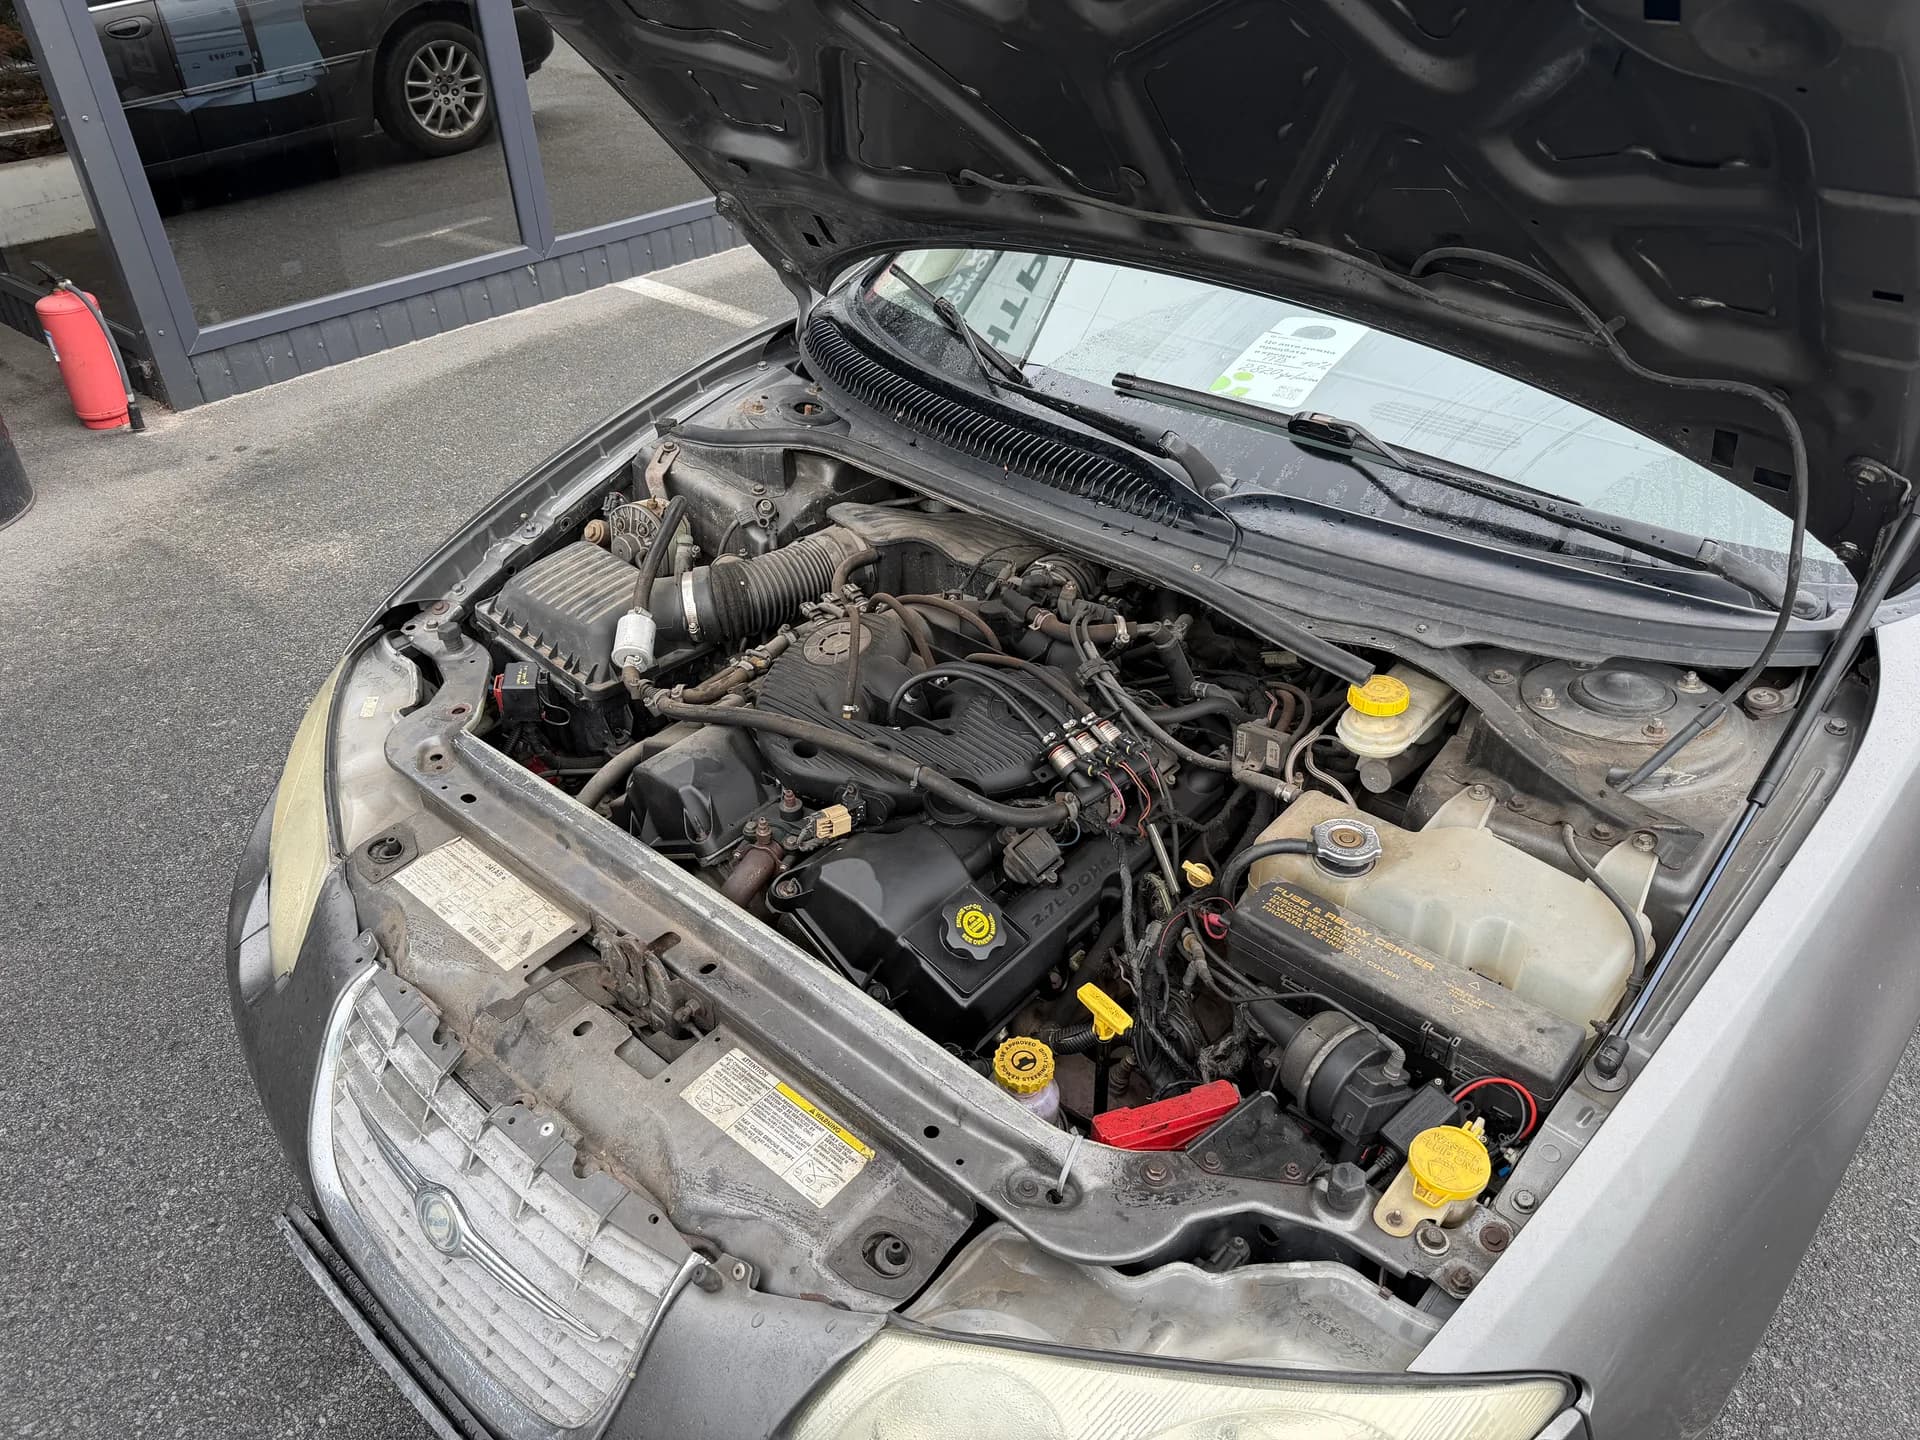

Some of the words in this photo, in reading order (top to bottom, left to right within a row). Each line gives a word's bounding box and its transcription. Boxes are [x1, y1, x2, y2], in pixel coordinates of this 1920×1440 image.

[1265, 902, 1303, 924] ALWAYS
[1273, 886, 1312, 908] FUSE
[1312, 906, 1322, 914] &
[1324, 911, 1372, 938] RELAY
[1374, 937, 1436, 971] CENTER
[1262, 905, 1309, 931] PROPERLY
[1367, 960, 1401, 980] COVER
[1005, 1040, 1037, 1051] APPROVED
[741, 1056, 769, 1077] ATTENTION
[1001, 1064, 1020, 1081] POWER
[814, 1111, 842, 1133] WARNING
[1433, 1131, 1481, 1163] WASHER
